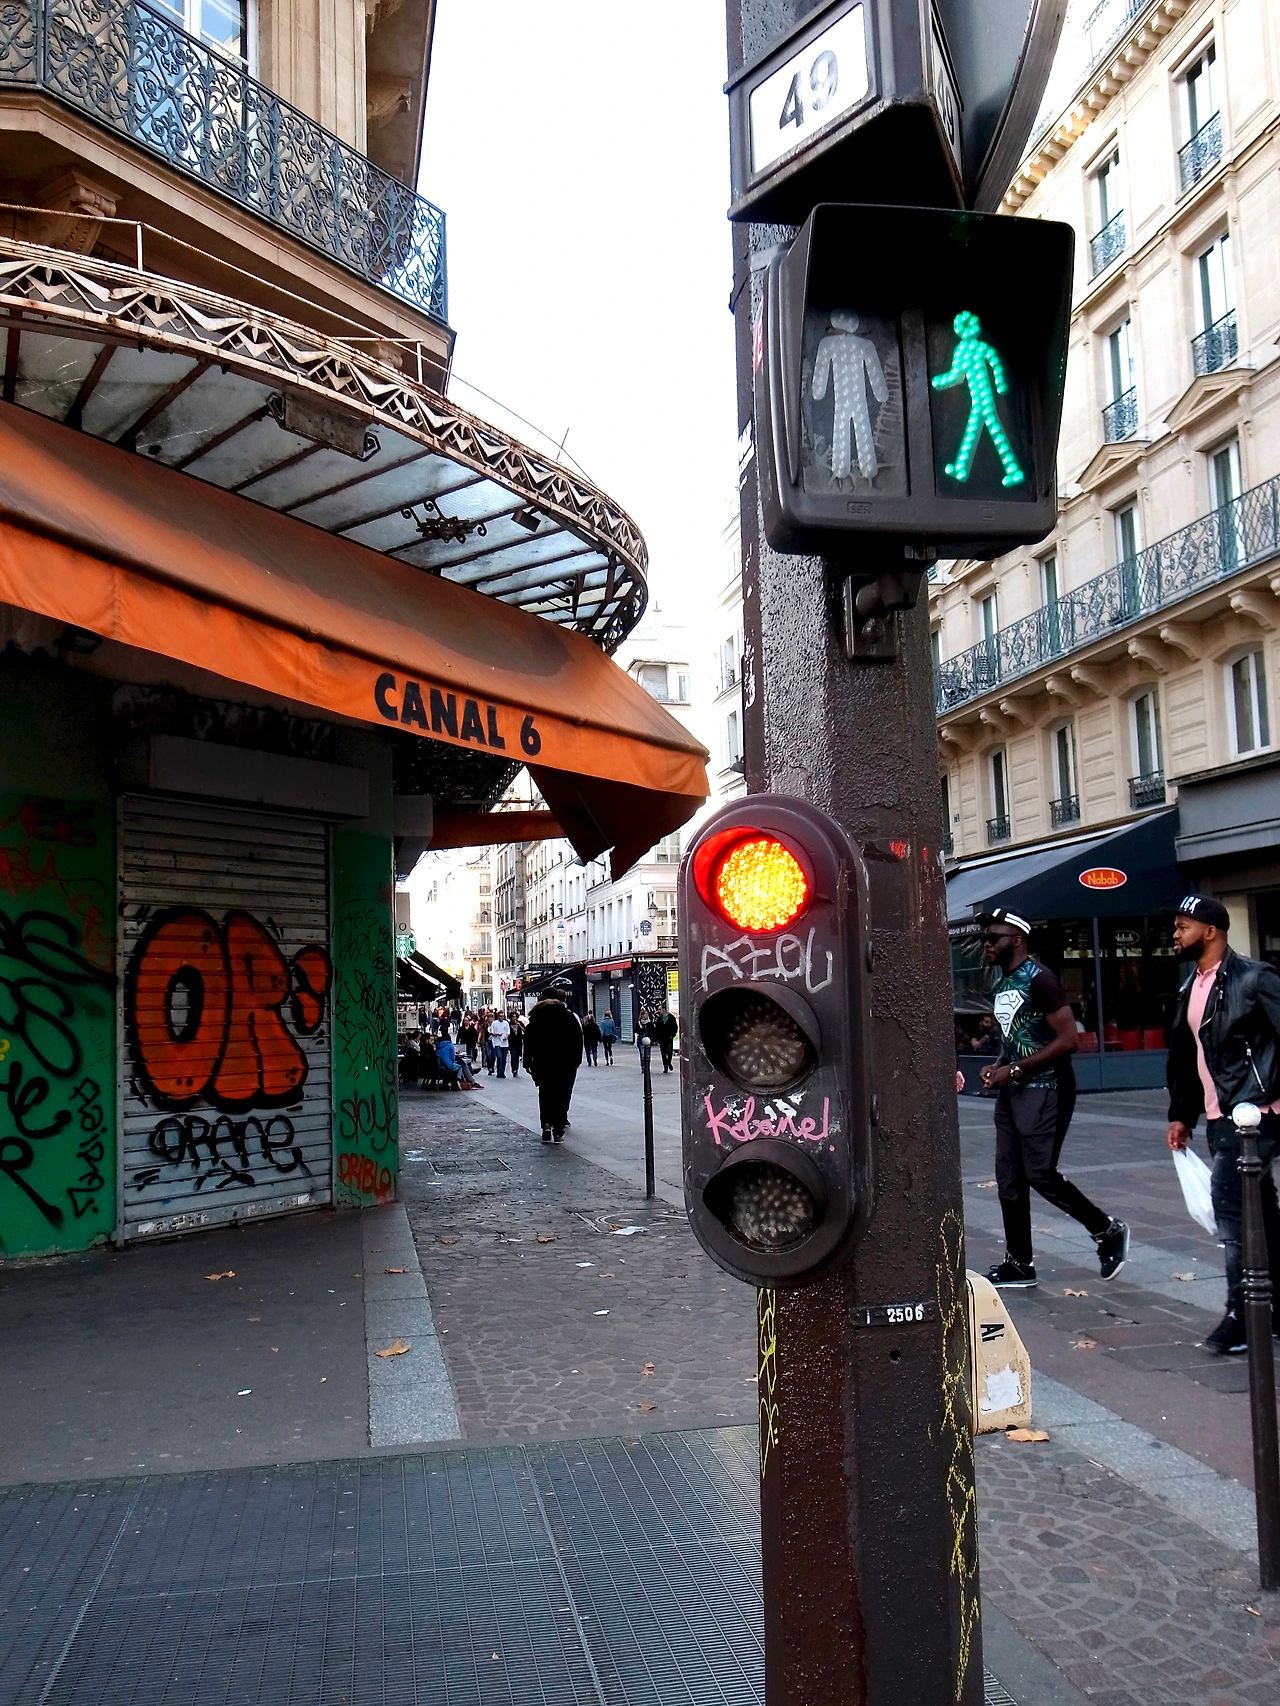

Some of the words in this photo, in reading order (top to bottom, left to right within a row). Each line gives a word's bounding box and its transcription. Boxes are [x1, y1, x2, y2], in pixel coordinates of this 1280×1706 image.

[776, 49, 839, 133] 49
[937, 66, 955, 146] 49
[374, 672, 506, 750] CANAL
[520, 714, 542, 756] 6
[1087, 872, 1119, 886] Nabab
[886, 1303, 925, 1323] 2506
